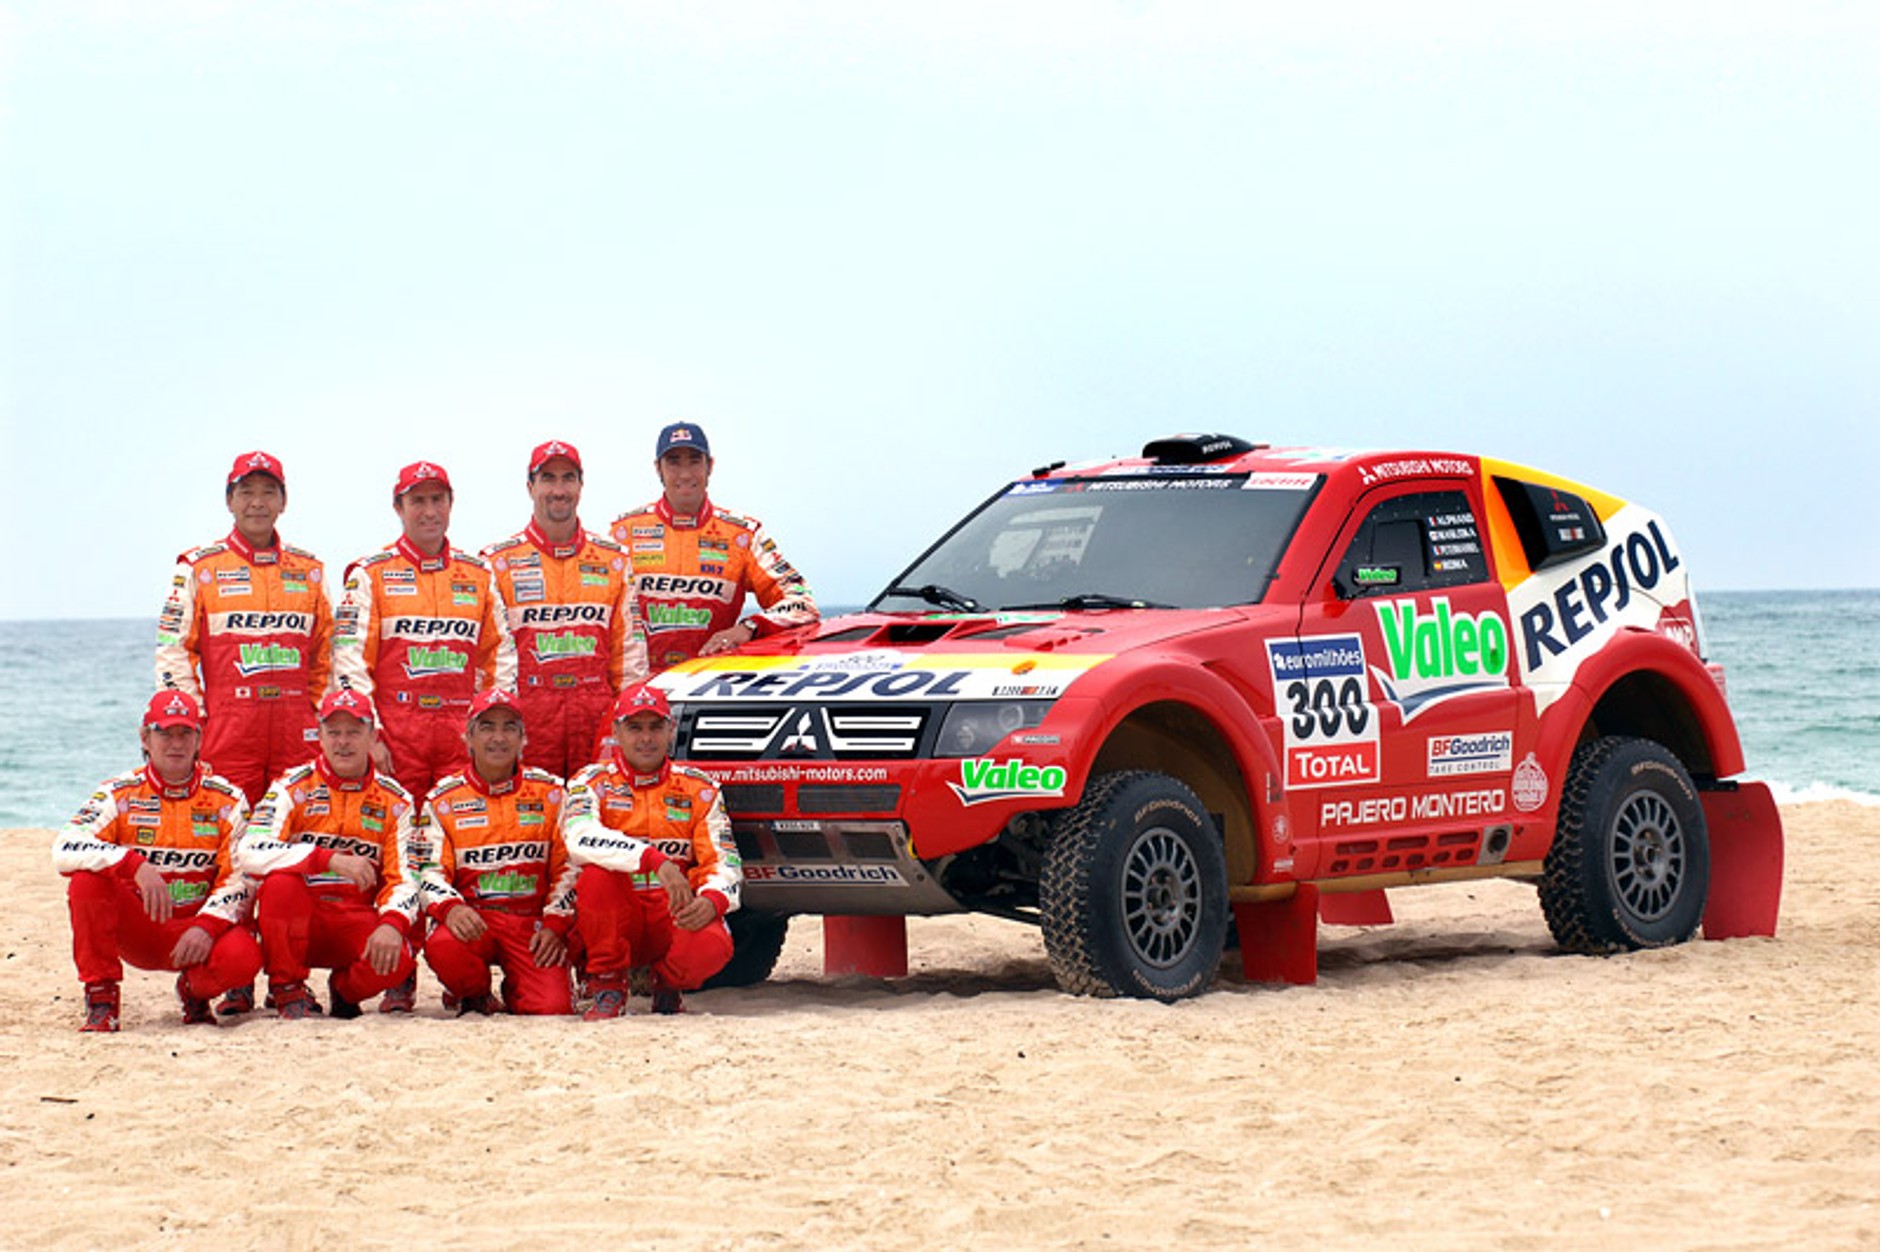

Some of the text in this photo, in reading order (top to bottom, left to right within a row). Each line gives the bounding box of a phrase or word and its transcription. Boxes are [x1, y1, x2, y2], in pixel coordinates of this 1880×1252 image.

[640, 576, 726, 596] REPSOL
[1520, 519, 1679, 673] REPSOL
[226, 613, 307, 630] REPSOL
[522, 605, 606, 623] REPSOL
[648, 603, 712, 625] Valeo
[394, 619, 477, 638] REPSOL
[536, 630, 597, 653] Valeo
[1376, 600, 1508, 681] Valeo
[240, 643, 300, 665] Valeo
[408, 646, 468, 668] Valeo
[687, 672, 972, 697] REPSOL
[1286, 677, 1369, 740] 300
[1431, 735, 1510, 757] BFGoodrich
[962, 760, 1065, 791] Valeo
[1294, 751, 1371, 778] TOTAL
[1320, 789, 1505, 828] PAJERO MONTERO
[464, 843, 545, 864] REPSOL
[741, 865, 898, 880] BFGoodrich
